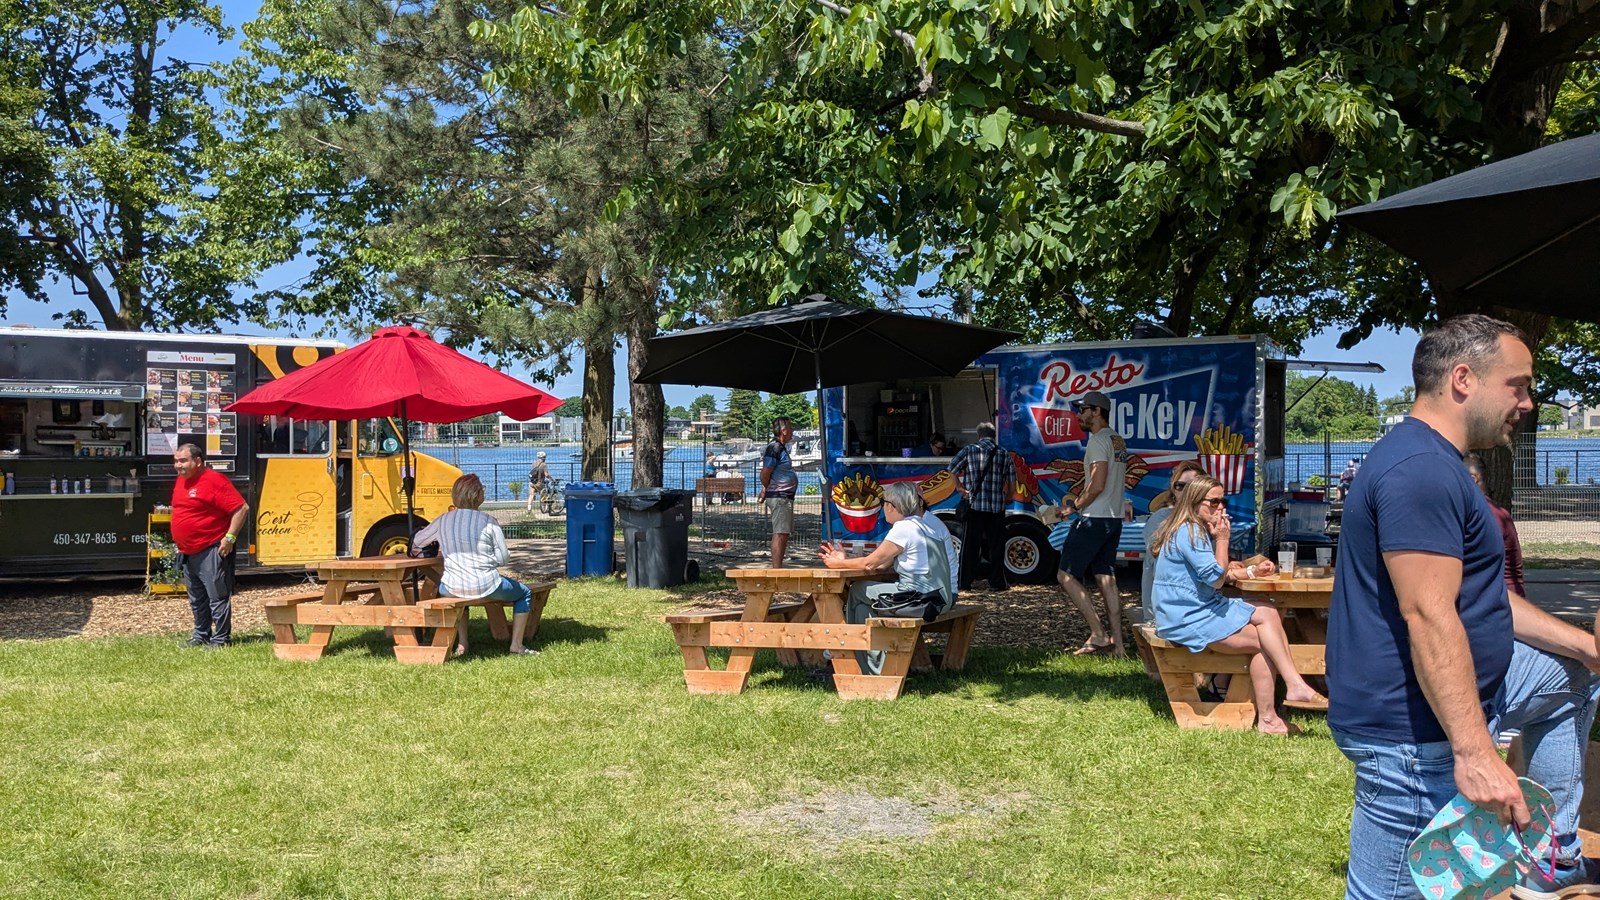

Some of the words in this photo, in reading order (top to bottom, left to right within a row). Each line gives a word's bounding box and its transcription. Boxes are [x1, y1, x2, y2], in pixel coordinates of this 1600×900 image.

[180, 354, 204, 362] Menu
[1040, 355, 1144, 402] Resto
[1044, 415, 1072, 437] CHEZ
[257, 510, 293, 526] C'est
[256, 525, 293, 535] cochon
[53, 532, 117, 545] 450-347-8635
